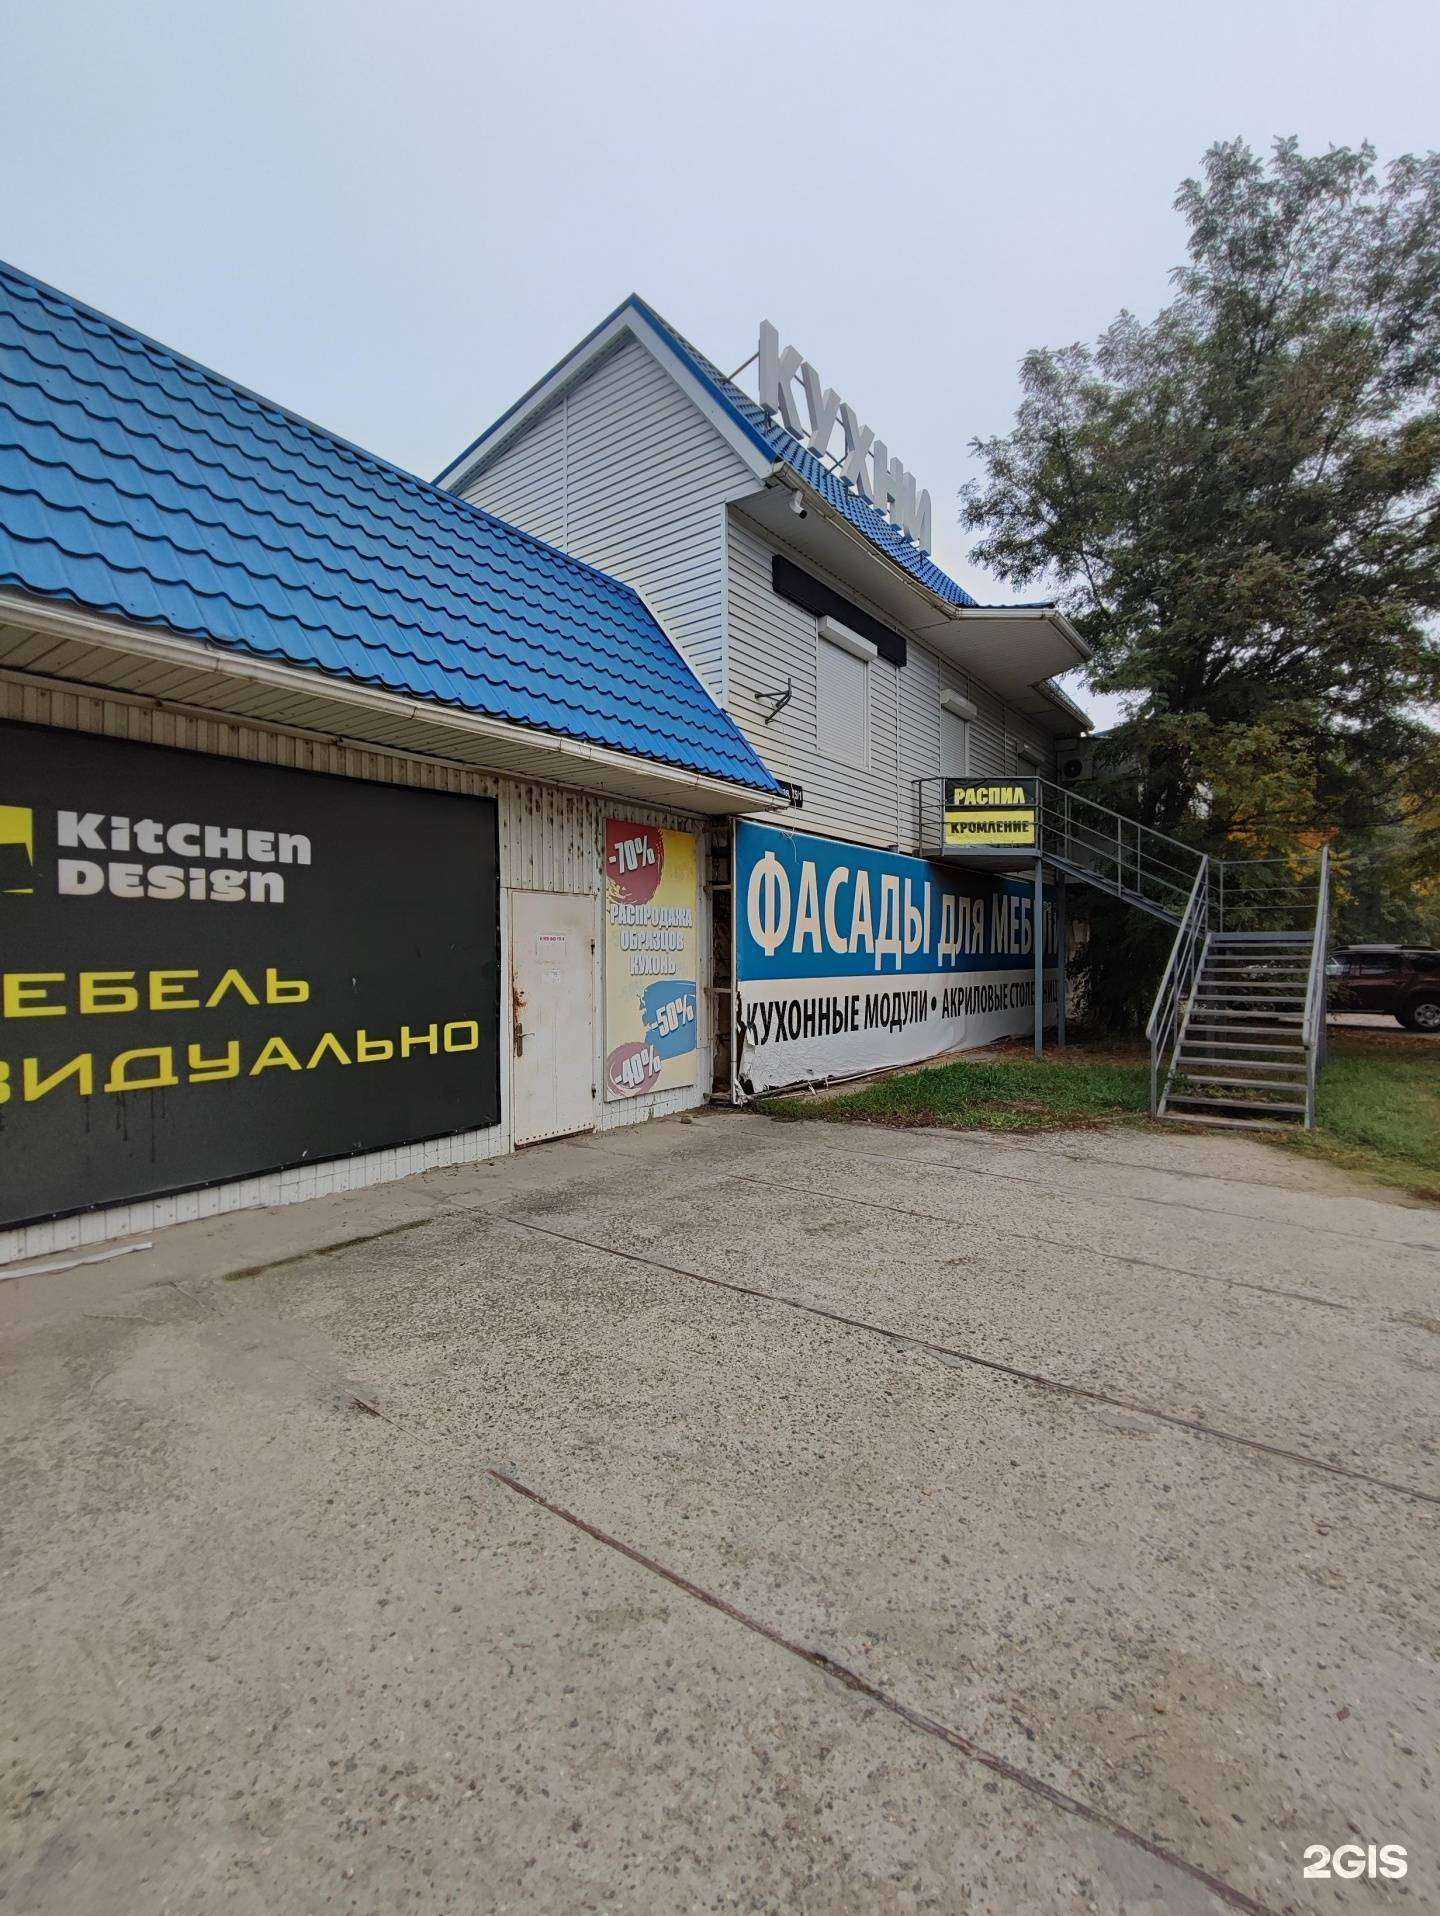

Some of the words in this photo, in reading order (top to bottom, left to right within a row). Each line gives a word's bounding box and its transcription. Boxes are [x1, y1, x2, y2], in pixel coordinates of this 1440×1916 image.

[758, 318, 931, 557] КУХНИ
[954, 786, 1026, 806] РАСПИЛ
[950, 820, 1030, 834] КРОМЛЕНИЕ
[608, 834, 656, 874] -70%
[610, 903, 693, 930] РАСПРОДАЖА
[747, 851, 931, 971] ФАСАДЫ
[938, 893, 985, 967] ДЛЯ
[620, 930, 685, 953] ОБРАЗЦОВ
[630, 954, 677, 976] КУХОНЬ
[649, 994, 694, 1037] -50%
[746, 994, 860, 1046] КУХОННЫЕ
[864, 989, 928, 1033] МОДУЛИ
[942, 983, 1009, 1019] АКРИЛОВЫЕ
[614, 1044, 662, 1088] -40%
